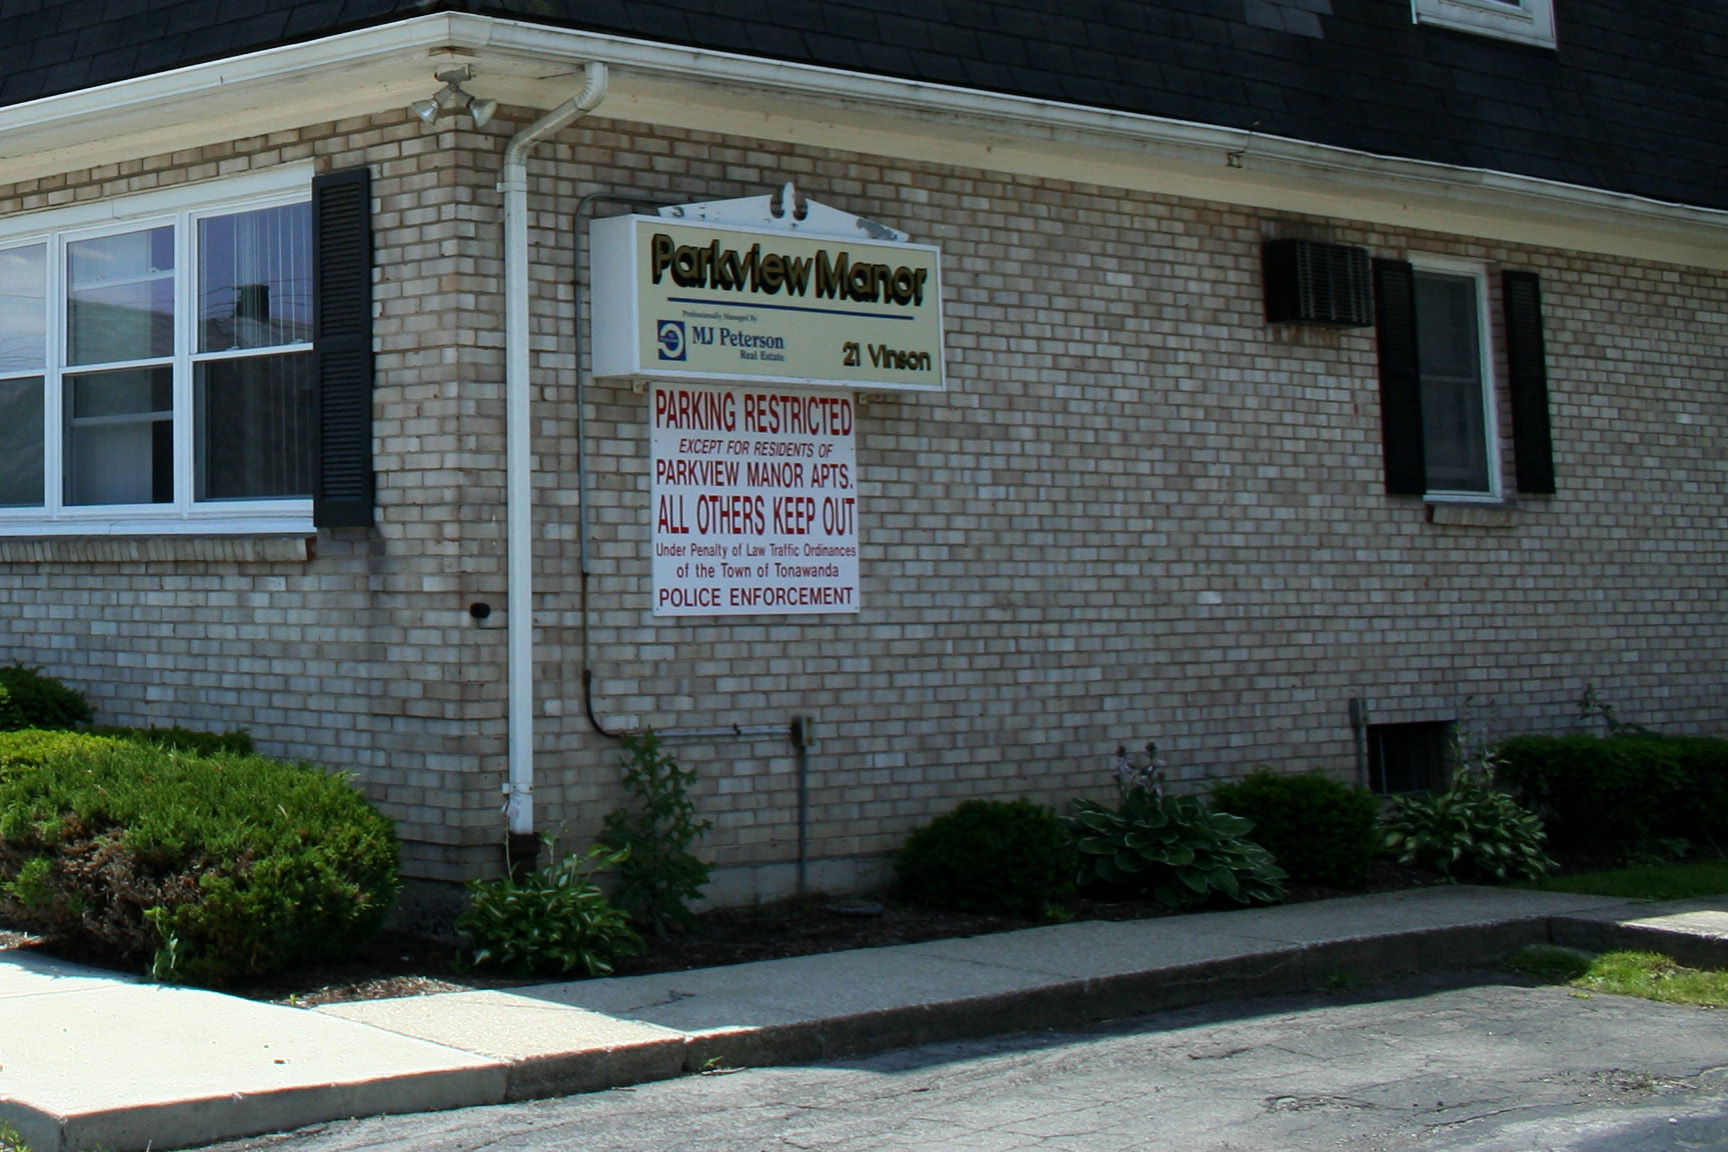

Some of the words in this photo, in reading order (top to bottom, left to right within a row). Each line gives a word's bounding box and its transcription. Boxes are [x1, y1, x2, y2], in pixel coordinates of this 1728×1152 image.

[651, 233, 813, 297] Parkview
[815, 249, 928, 306] Manor
[692, 326, 714, 345] MJ
[720, 328, 784, 349] Peterson
[740, 350, 757, 360] Real
[760, 350, 784, 361] Estate
[842, 341, 860, 366] 21
[867, 343, 931, 371] Vinson
[655, 389, 736, 432] PARKING
[744, 393, 852, 436] RESTRICTED
[679, 438, 723, 455] EXCEPT
[726, 440, 749, 456] FOR
[754, 441, 814, 458] RESIDENTS
[818, 443, 834, 458] OF
[656, 458, 739, 486] PARKVIEW
[747, 461, 803, 488] MANOR
[811, 463, 853, 489] APTS.
[657, 494, 689, 535] ALL
[696, 494, 765, 536] OTHERS
[773, 496, 815, 536] KEEP
[823, 496, 855, 536] OUT
[656, 543, 686, 557] Under
[691, 543, 727, 559] Penalty
[732, 543, 742, 557] of
[746, 543, 765, 557] Law
[769, 543, 799, 557] Traffic
[803, 543, 856, 557] Ordinances
[676, 563, 689, 578] of
[696, 563, 715, 578] the
[721, 563, 751, 578] Town
[757, 563, 769, 578] of
[774, 563, 839, 578] Tonawanda
[659, 587, 721, 607] POLICE
[730, 587, 853, 606] ENFORCEMENT
